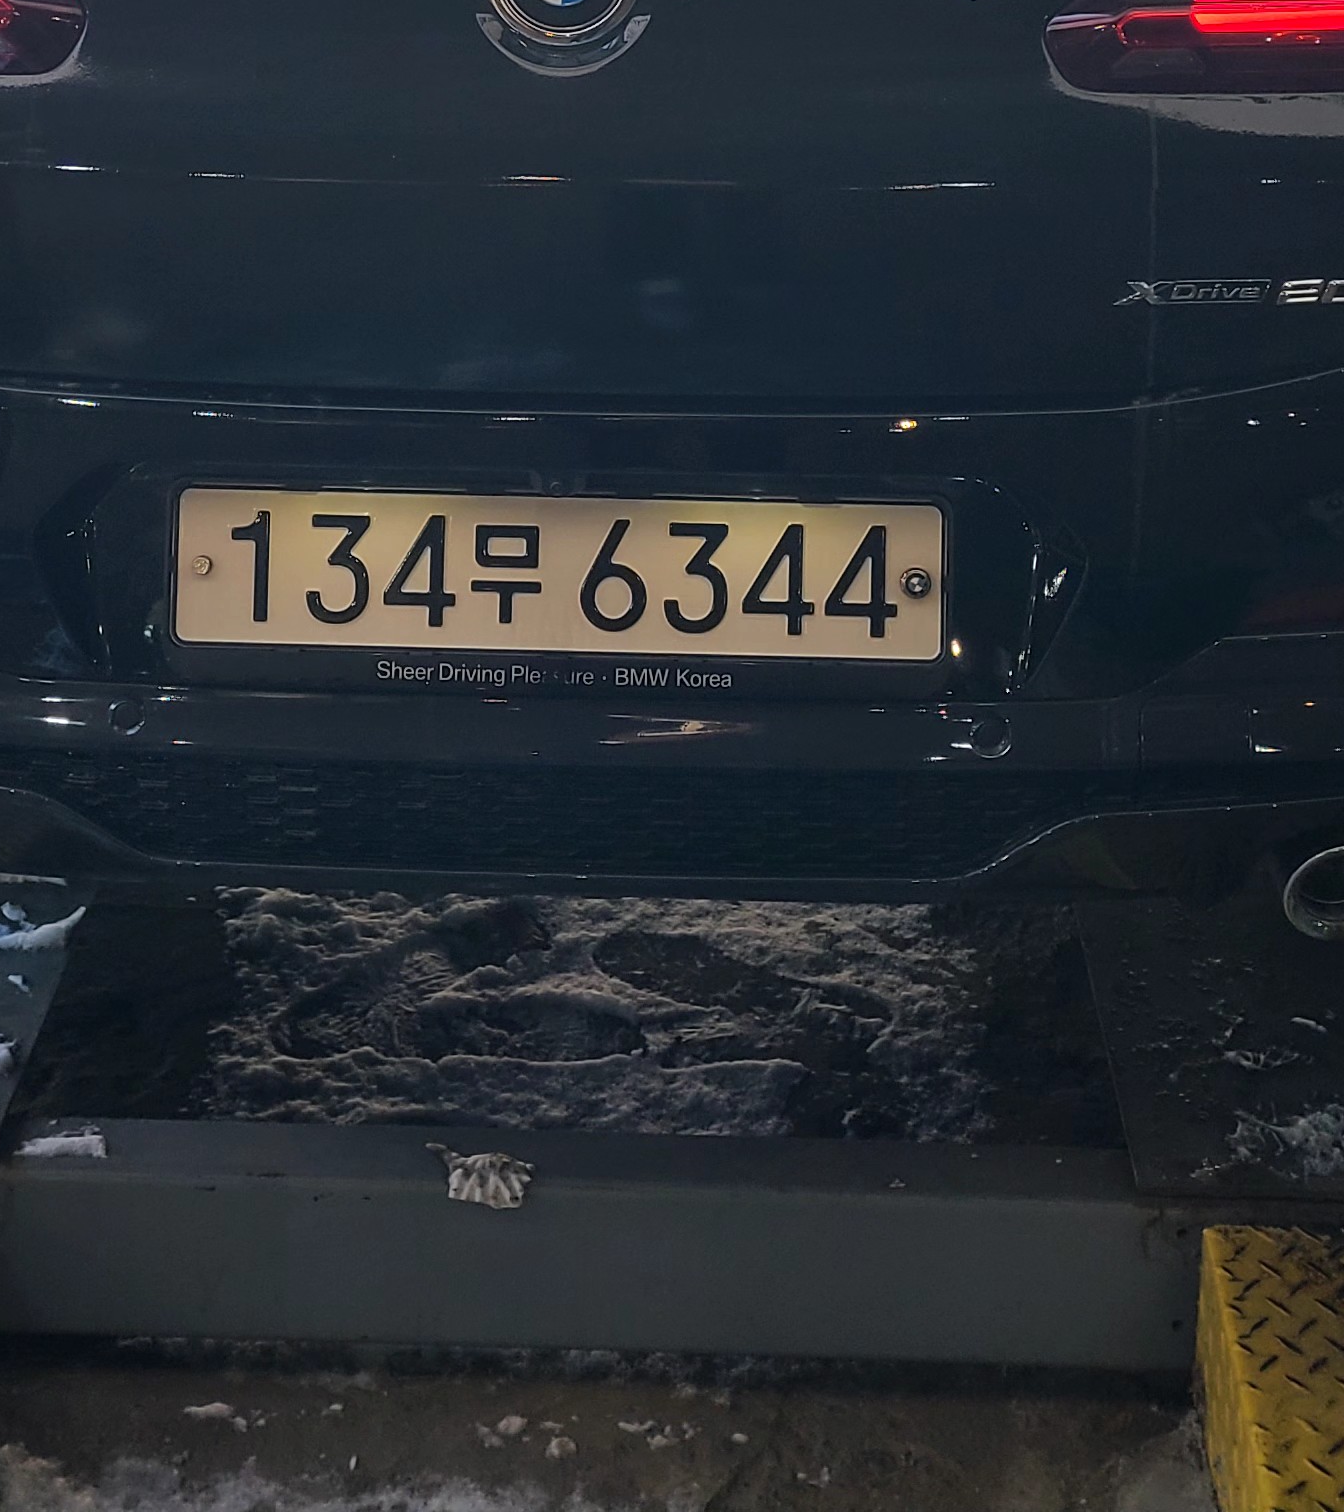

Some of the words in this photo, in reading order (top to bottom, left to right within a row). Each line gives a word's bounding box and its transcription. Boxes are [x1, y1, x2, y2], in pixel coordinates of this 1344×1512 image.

[230, 508, 542, 629] 134무
[578, 518, 900, 640] 6344
[376, 660, 434, 682] Sheer
[439, 662, 505, 686] Driving
[614, 668, 669, 686] BMW
[676, 669, 732, 688] Korea
